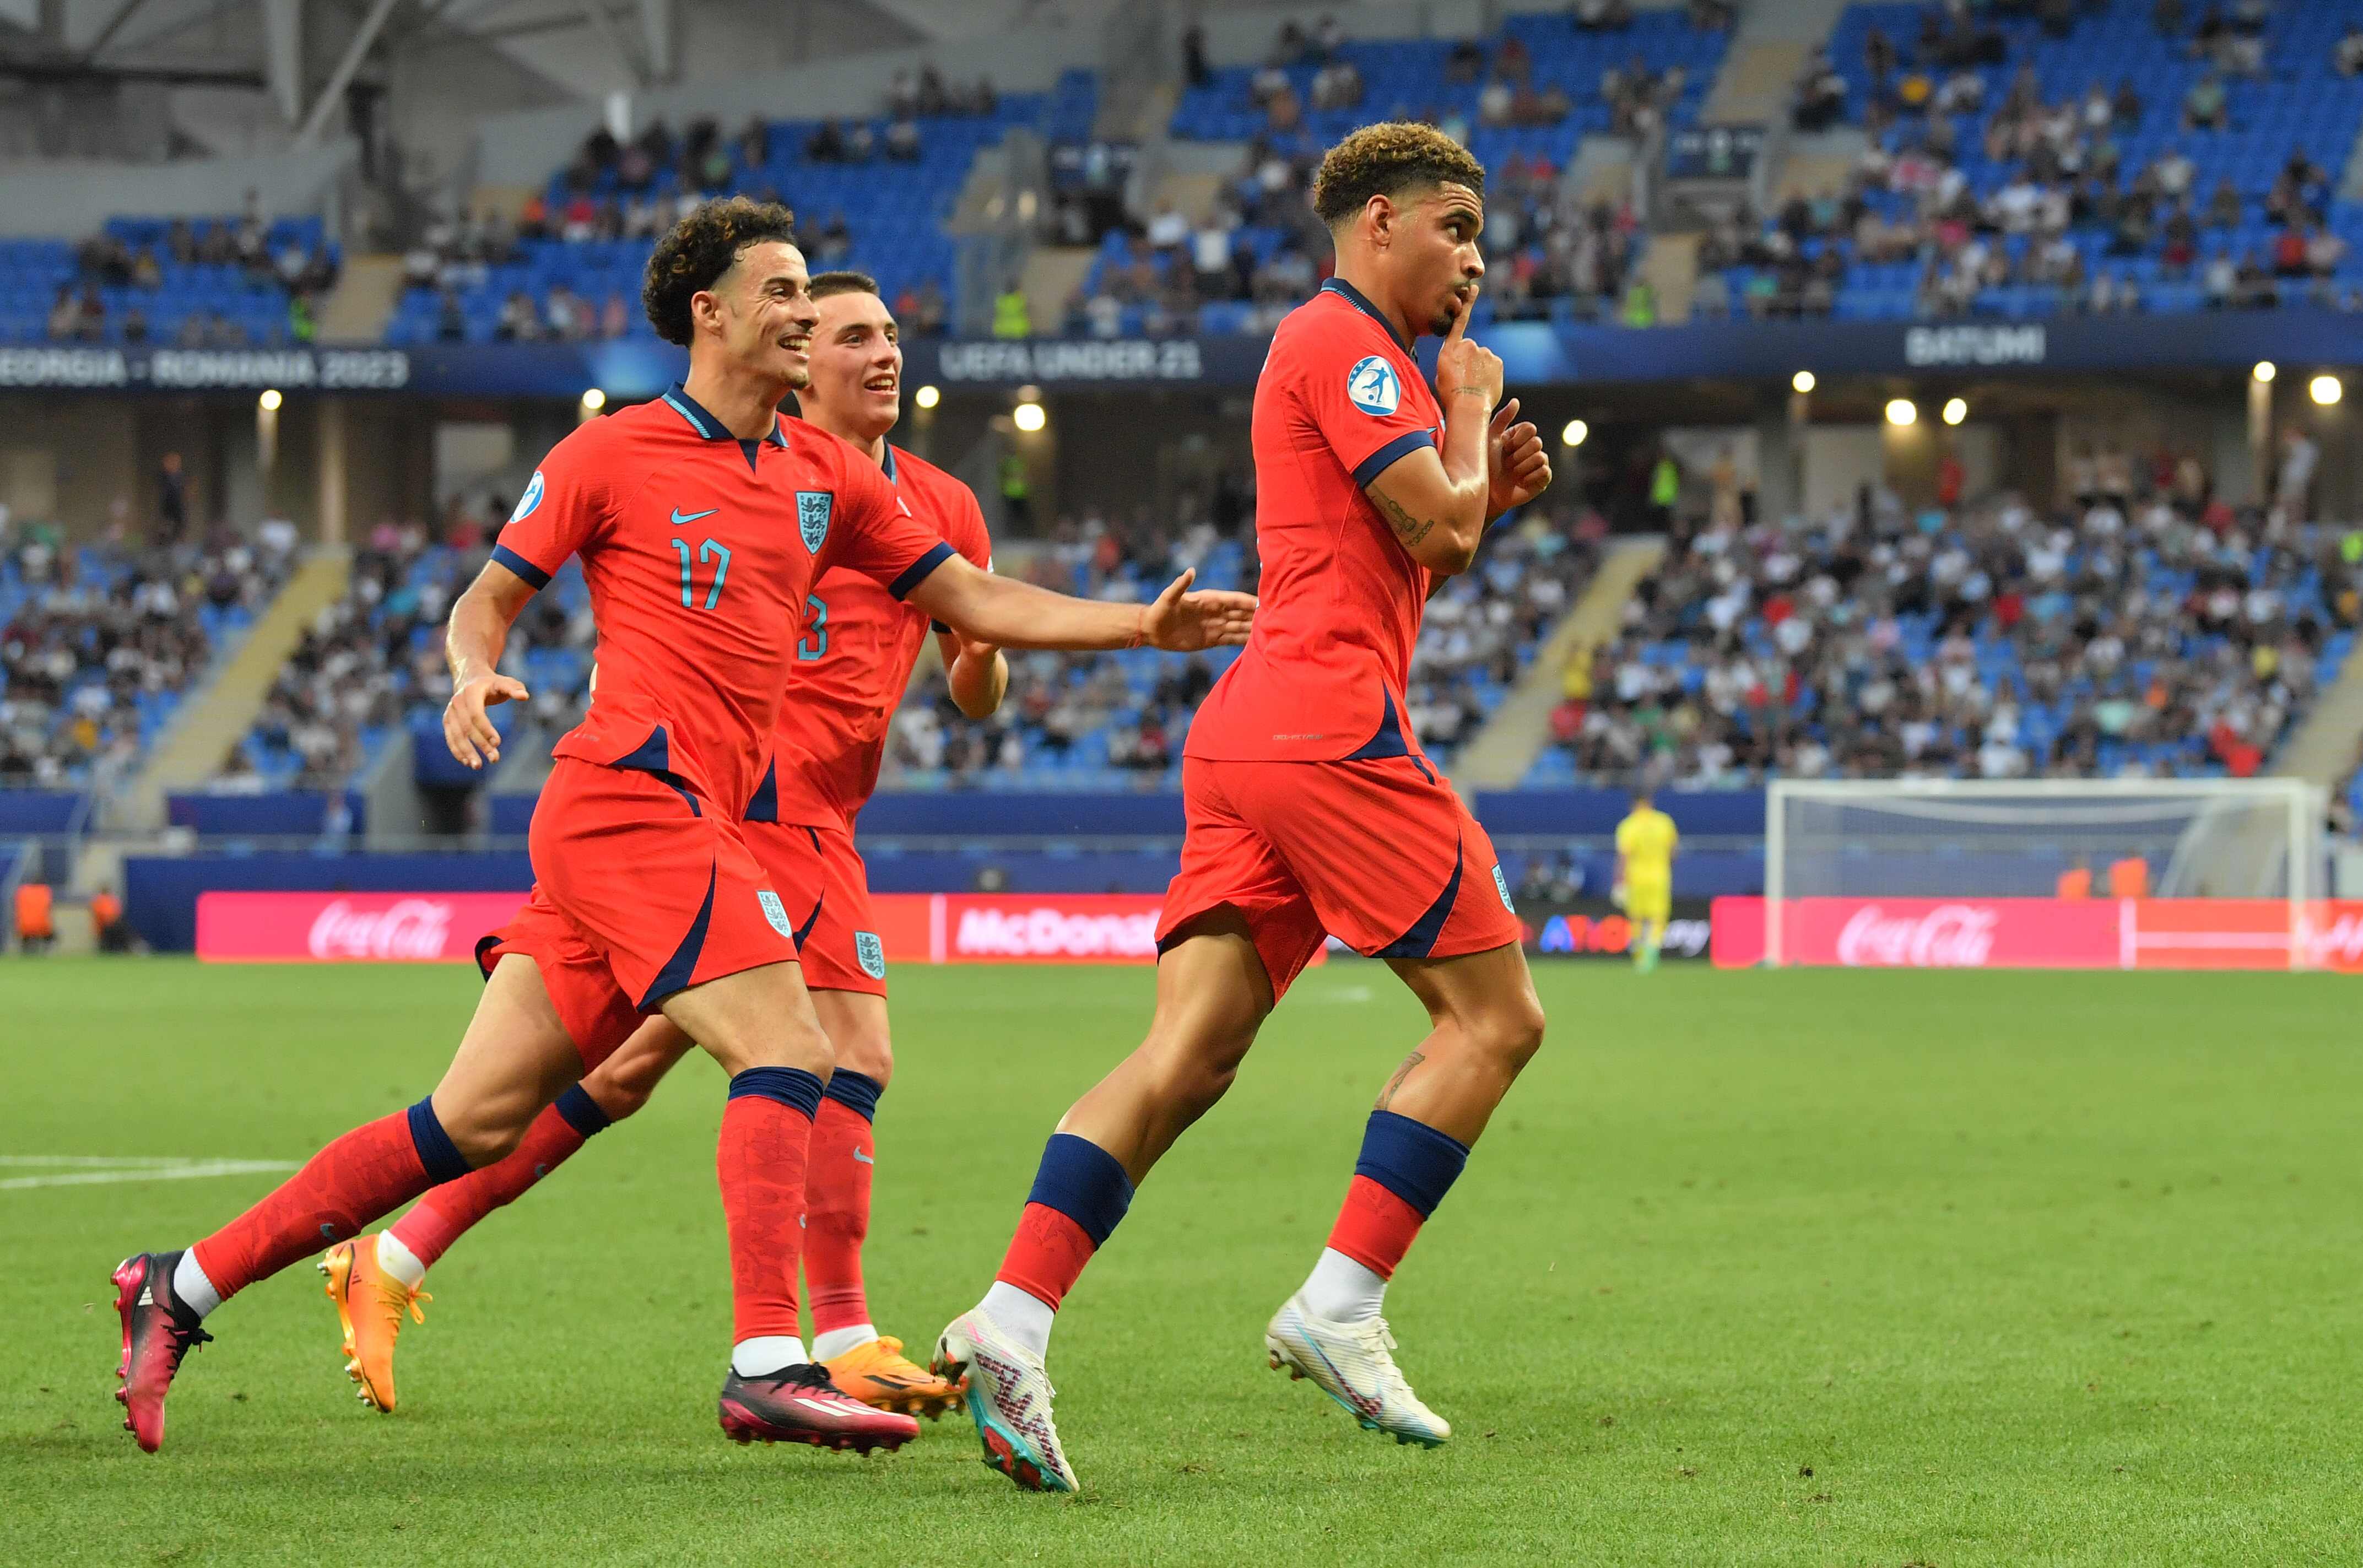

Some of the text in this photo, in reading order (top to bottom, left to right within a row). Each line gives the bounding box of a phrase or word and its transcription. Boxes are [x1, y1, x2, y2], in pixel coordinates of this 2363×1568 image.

[940, 339, 1201, 380] UEFA UNDER 21
[1906, 325, 2046, 365] BATUMI
[152, 349, 317, 386] ROMANIA
[322, 349, 409, 386] 2023
[671, 538, 731, 609] 17
[798, 594, 828, 661] 3
